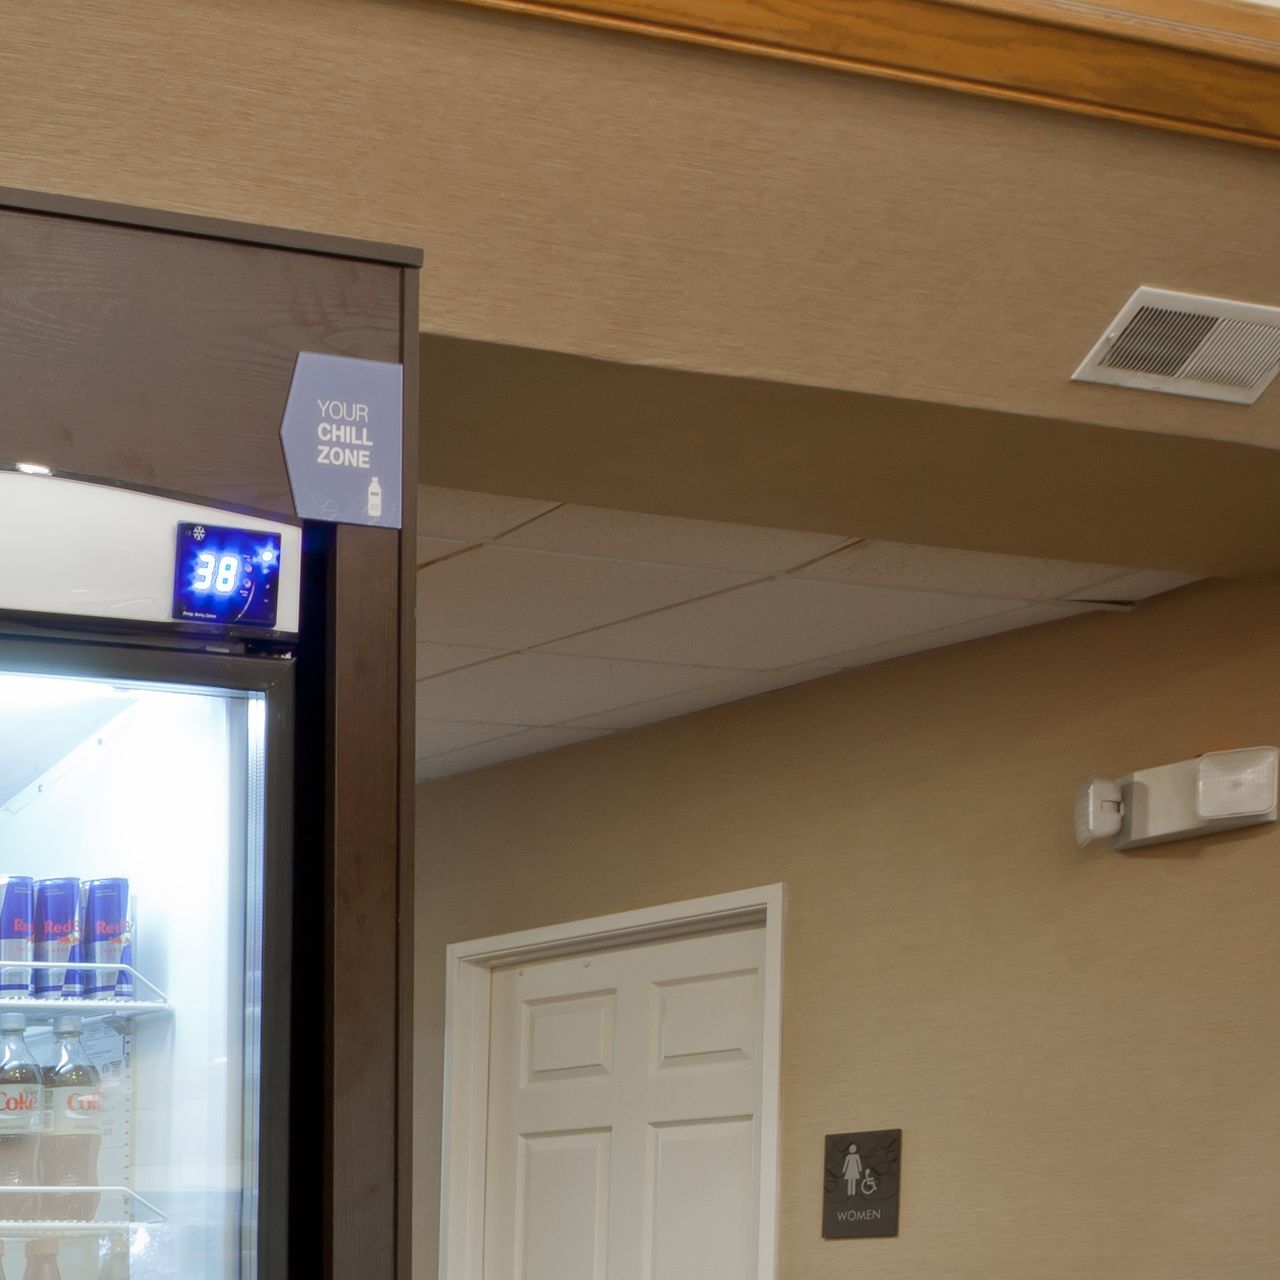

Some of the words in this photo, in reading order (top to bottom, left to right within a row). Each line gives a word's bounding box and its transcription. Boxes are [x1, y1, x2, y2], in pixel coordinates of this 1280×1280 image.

[318, 400, 369, 423] YOUR
[317, 423, 373, 446] CHILL
[317, 445, 371, 468] ZONE
[193, 553, 238, 593] 38
[837, 1209, 881, 1221] WOMEN
